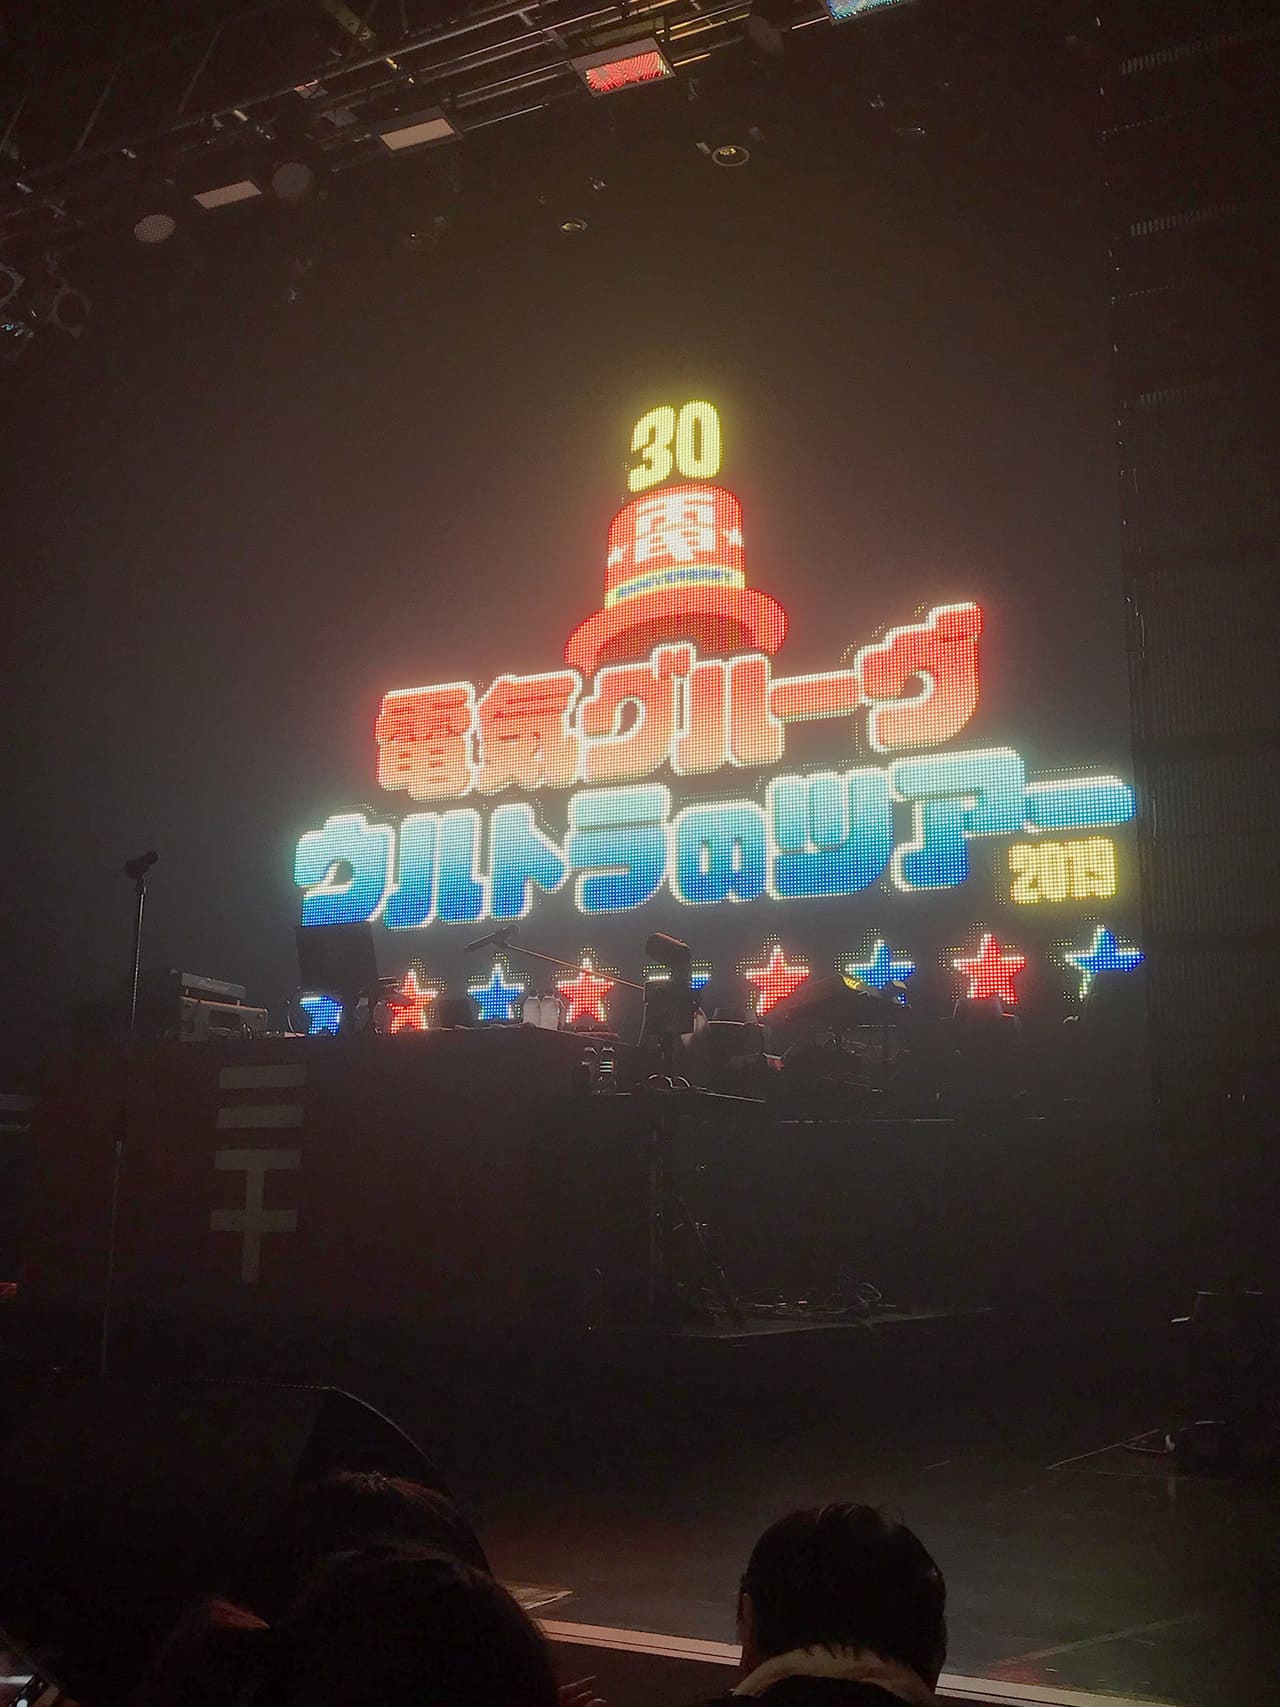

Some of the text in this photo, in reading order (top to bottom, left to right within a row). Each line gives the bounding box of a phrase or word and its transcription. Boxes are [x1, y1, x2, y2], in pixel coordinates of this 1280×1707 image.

[628, 400, 722, 492] 30
[294, 745, 1137, 931] ウルトラのツアー
[1008, 836, 1118, 905] 2019
